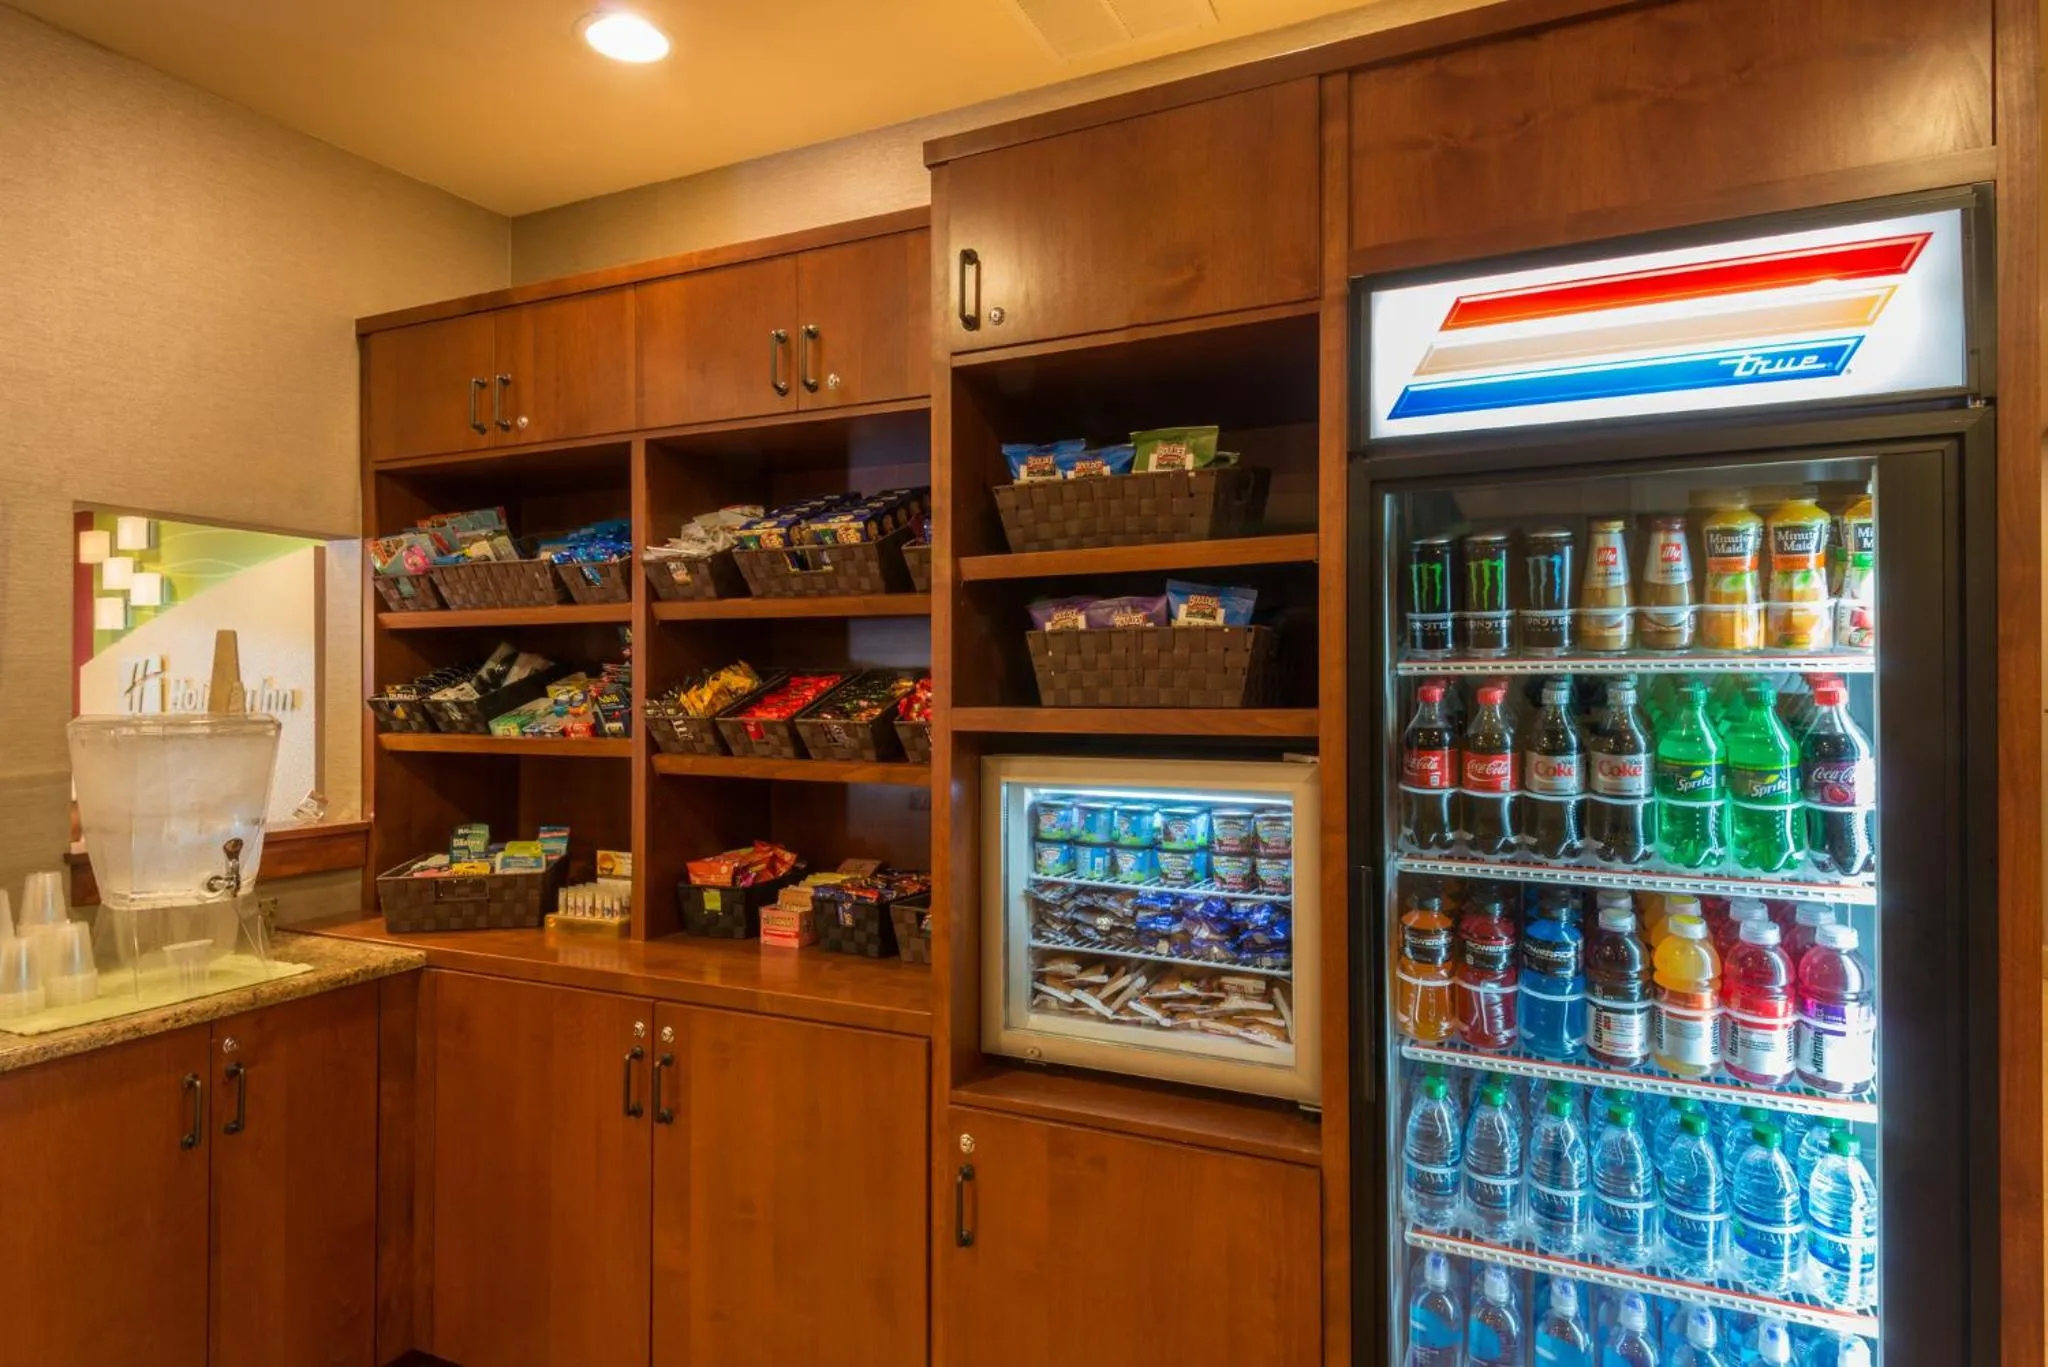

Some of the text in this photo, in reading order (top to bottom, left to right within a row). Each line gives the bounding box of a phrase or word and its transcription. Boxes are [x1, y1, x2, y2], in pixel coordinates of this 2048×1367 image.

[1534, 760, 1574, 777] Coke
[1599, 760, 1642, 777] Coke
[1676, 776, 1714, 793] Sprite
[1749, 778, 1788, 798] Sprite
